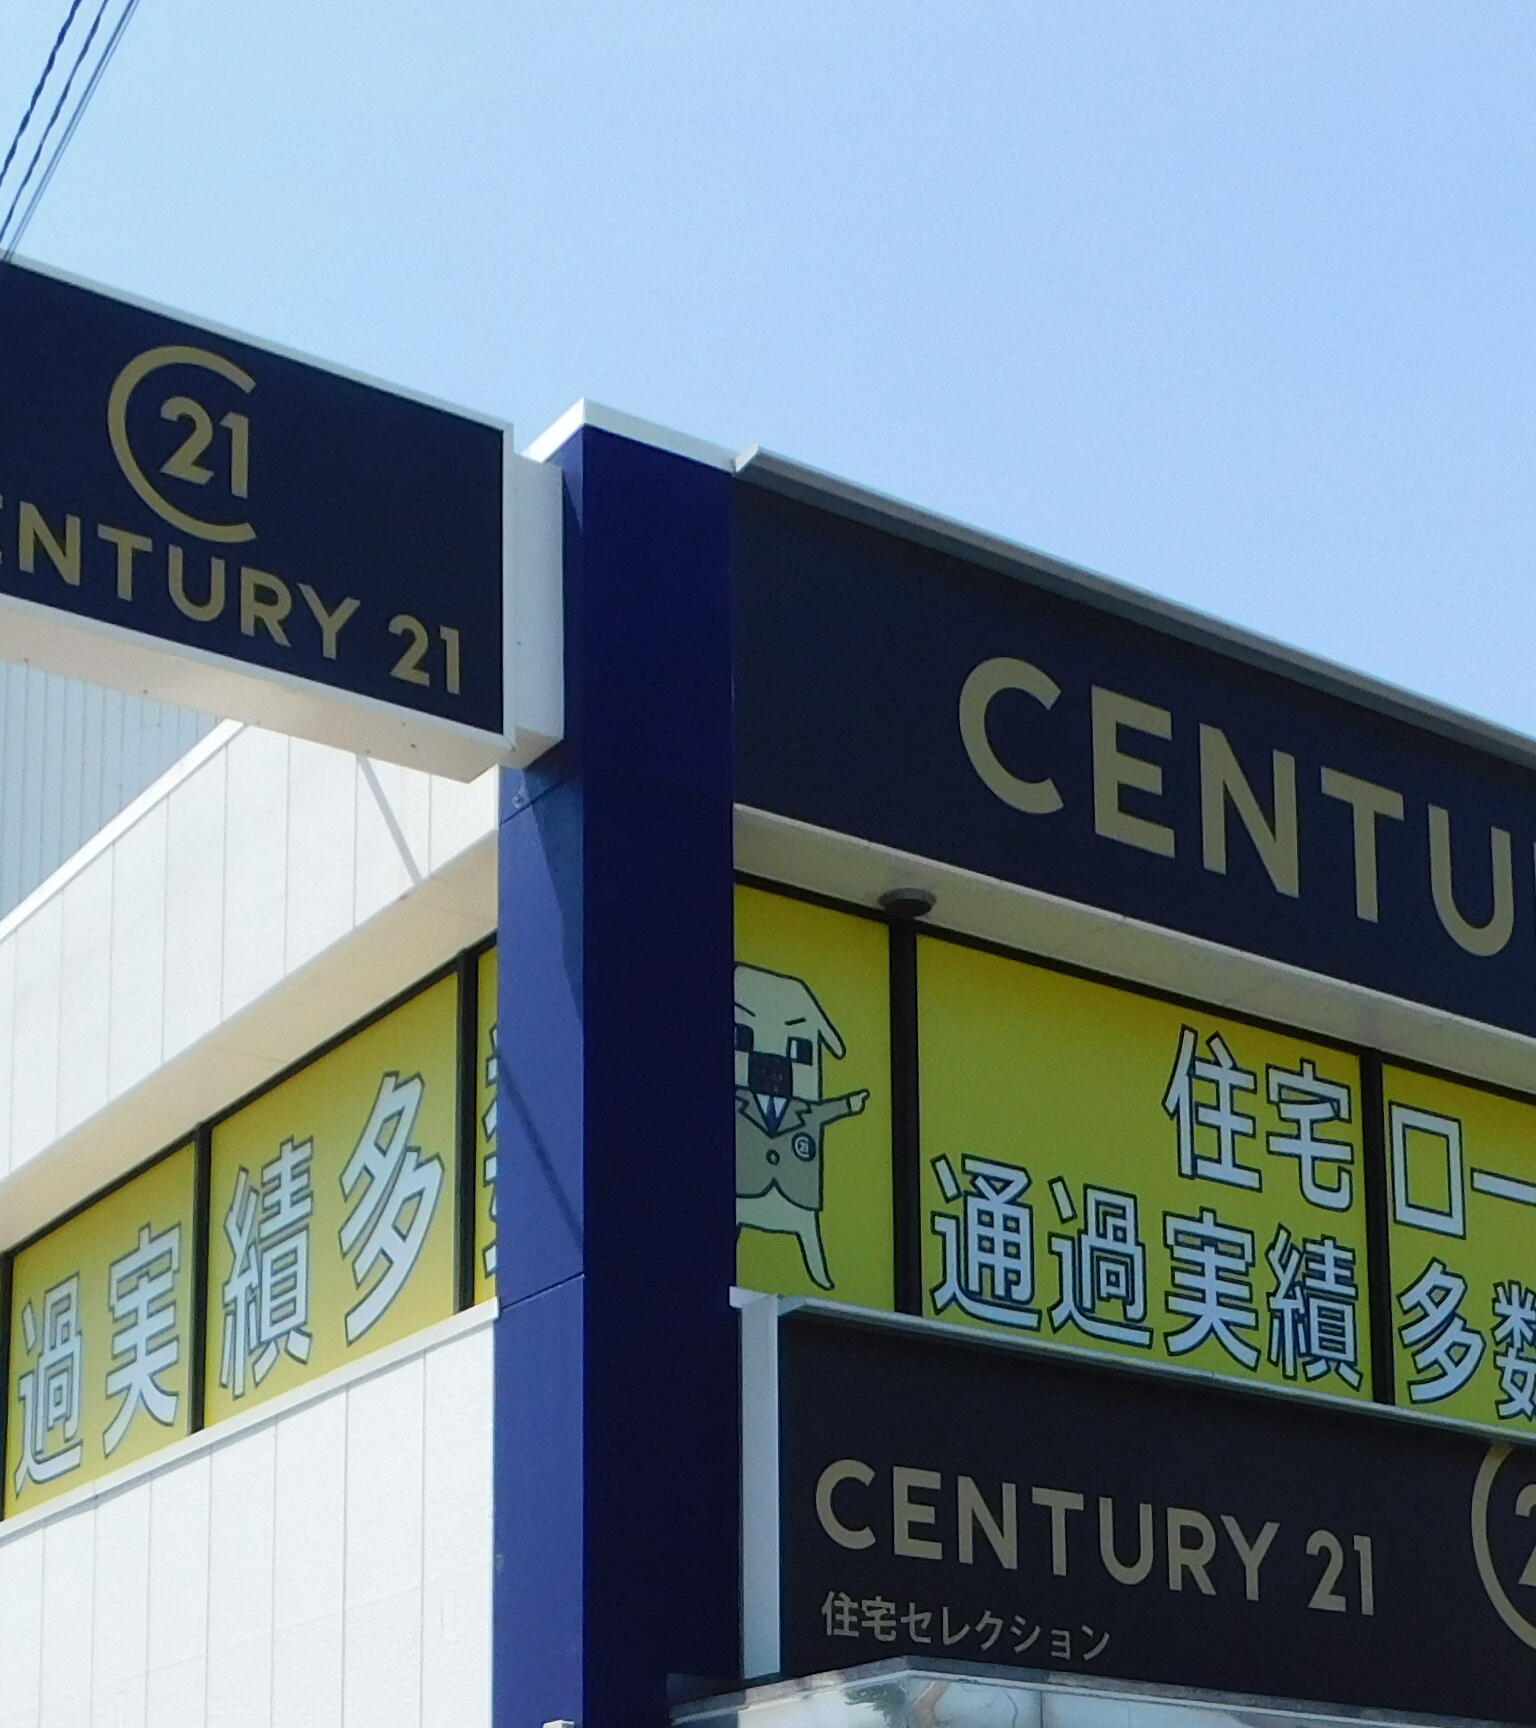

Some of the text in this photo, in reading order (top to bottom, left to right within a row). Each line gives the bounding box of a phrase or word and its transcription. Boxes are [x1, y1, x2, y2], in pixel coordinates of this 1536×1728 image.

[387, 614, 462, 696] 21
[815, 1458, 1376, 1617] CENTURY 21
[820, 1591, 1111, 1662] 住宅セレクション
